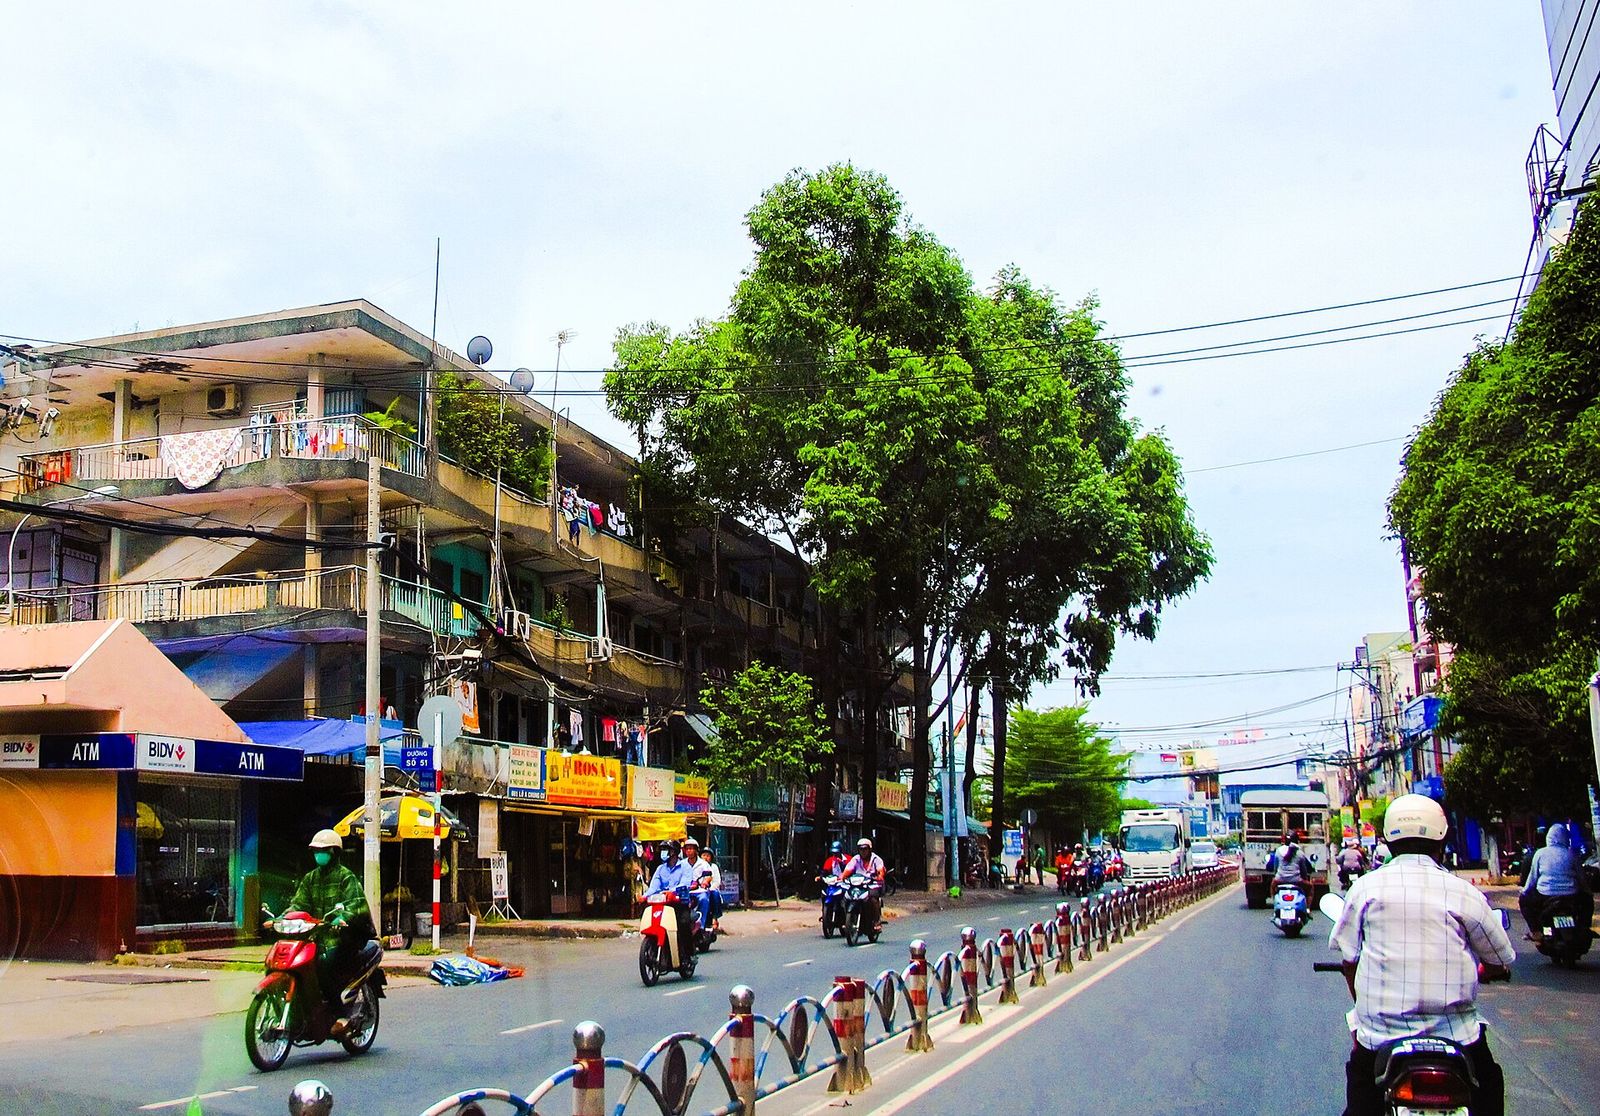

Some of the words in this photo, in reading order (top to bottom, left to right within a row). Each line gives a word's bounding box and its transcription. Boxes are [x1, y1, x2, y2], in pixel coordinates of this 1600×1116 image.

[4, 742, 25, 753] BIDV
[72, 742, 99, 761] ATM
[149, 741, 174, 758] BIDV
[239, 751, 264, 771] ATM
[574, 760, 607, 777] ROSA
[715, 791, 744, 808] EVERON
